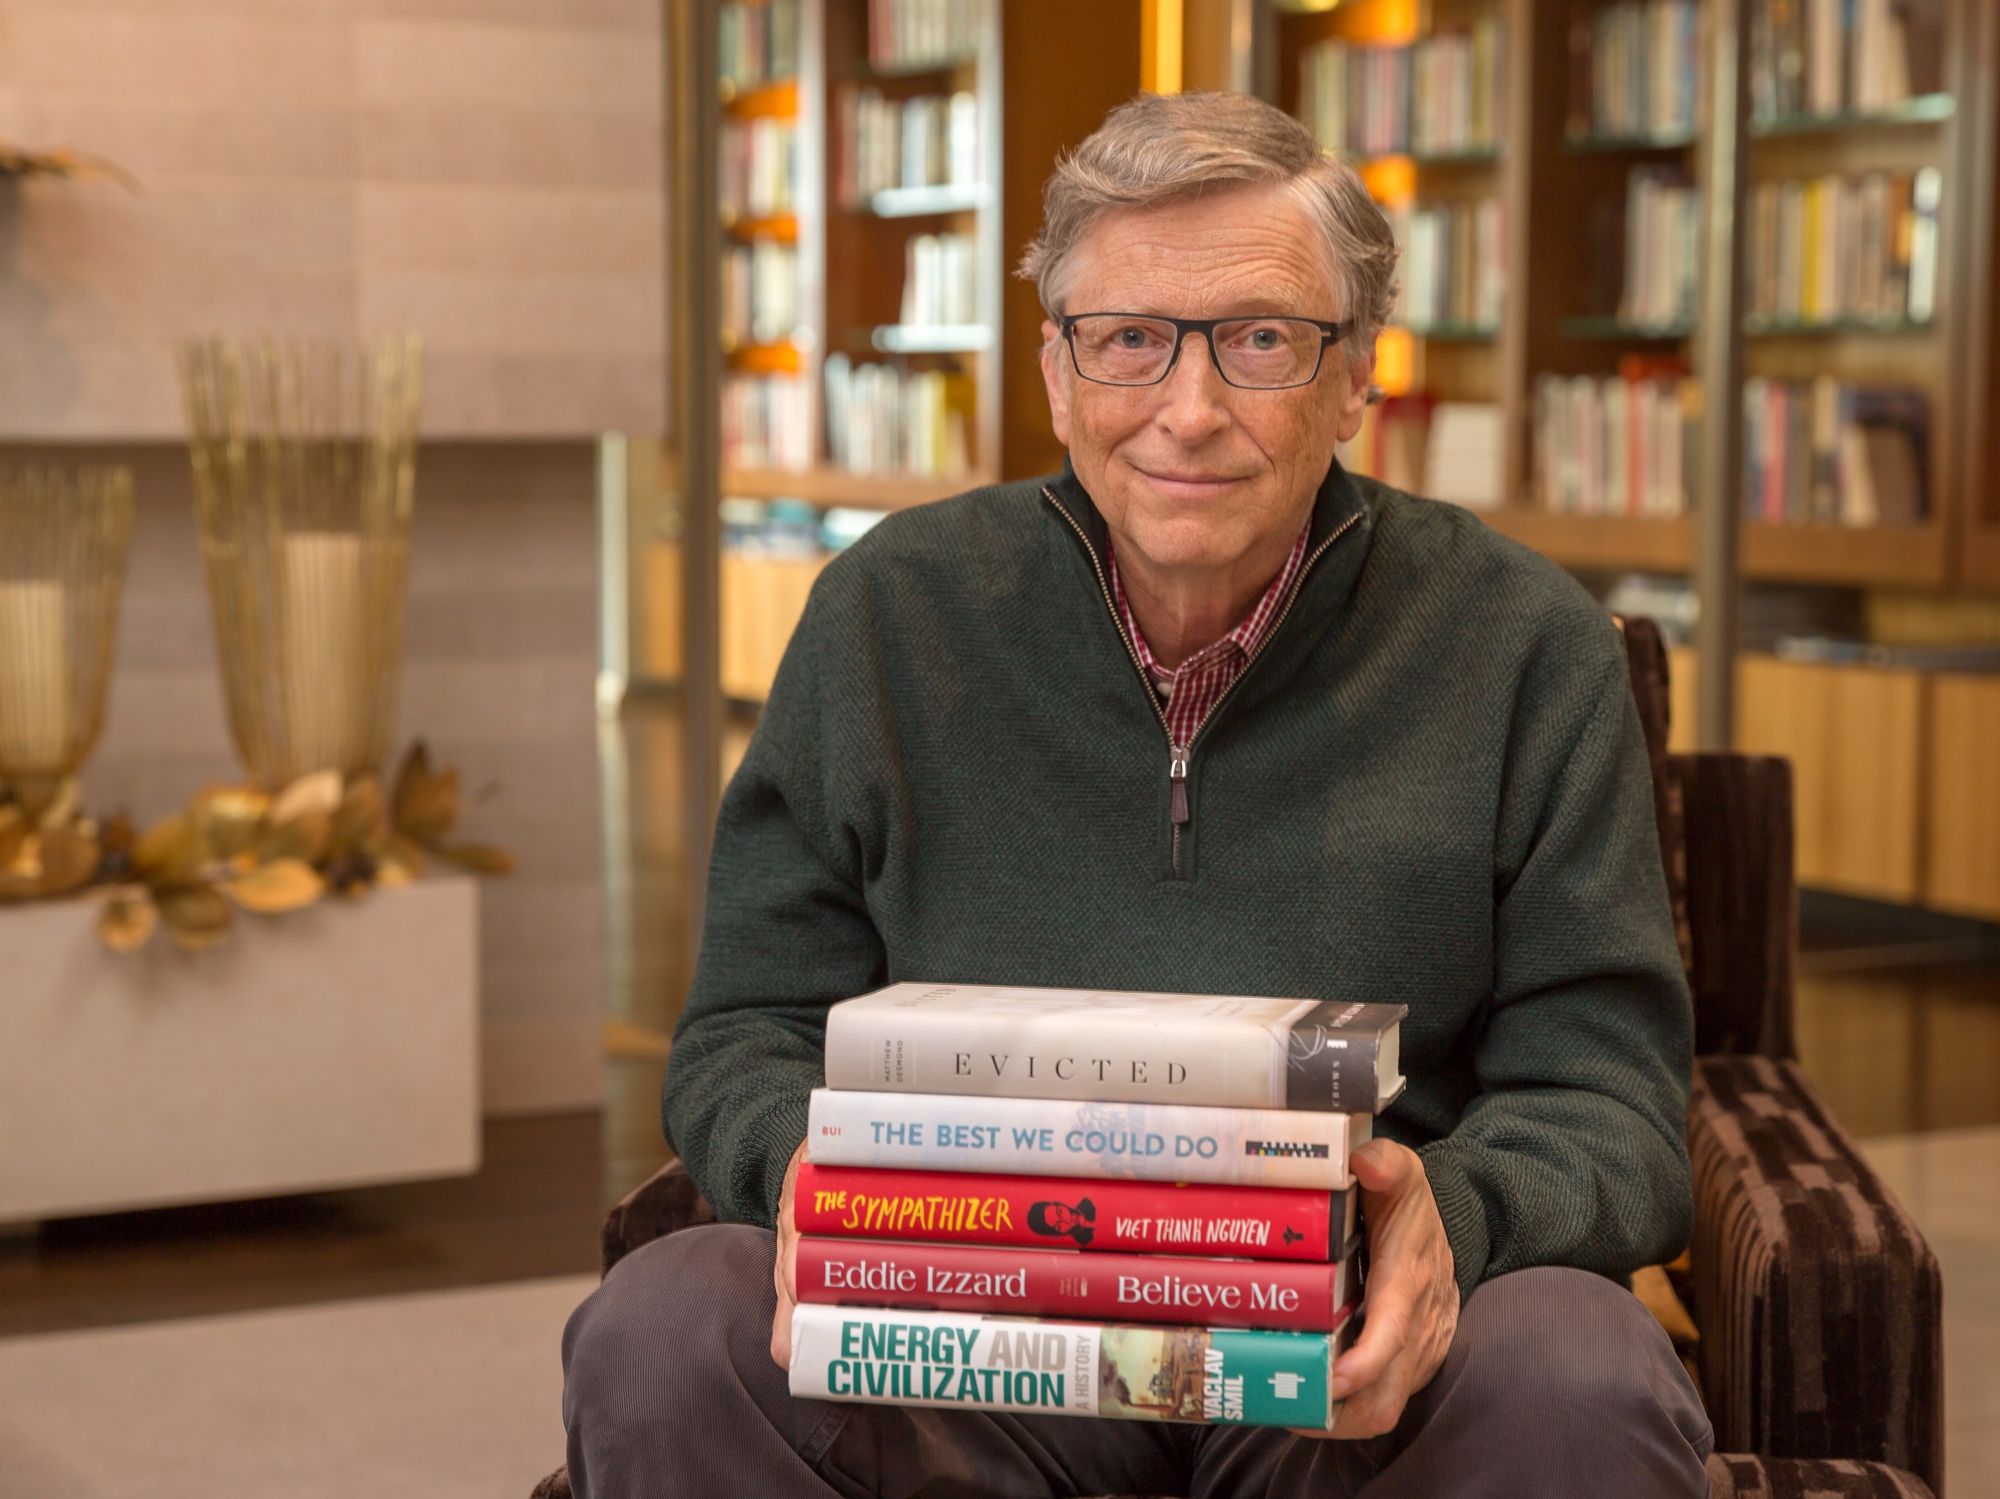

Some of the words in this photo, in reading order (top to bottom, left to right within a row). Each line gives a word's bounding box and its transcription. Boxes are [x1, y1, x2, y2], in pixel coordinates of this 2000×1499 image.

[953, 1053, 1187, 1085] EVICTED
[822, 1126, 842, 1136] BUI
[870, 1121, 924, 1146] THE
[936, 1124, 1001, 1149] BEST
[1012, 1128, 1054, 1152] WE
[1065, 1130, 1165, 1157] COULD
[1175, 1136, 1218, 1159] DO
[813, 1190, 847, 1214] THE
[842, 1194, 1013, 1232] SYMPATHIZER
[1115, 1217, 1152, 1239] VIET
[1155, 1218, 1202, 1243] THANH
[1206, 1218, 1271, 1246] NGUYEN
[823, 1260, 917, 1292] Eddie
[926, 1266, 1027, 1298] Izzard
[1117, 1275, 1241, 1308] Believe
[1249, 1282, 1299, 1312] Me
[840, 1321, 981, 1365] ENERGY
[987, 1330, 1067, 1371] AND
[827, 1359, 1065, 1408] CIVILIZATION
[1075, 1334, 1091, 1397] HISTORY
[1204, 1348, 1224, 1419] VACLAV
[1075, 1401, 1090, 1411] A
[1224, 1374, 1244, 1421] SMIL
